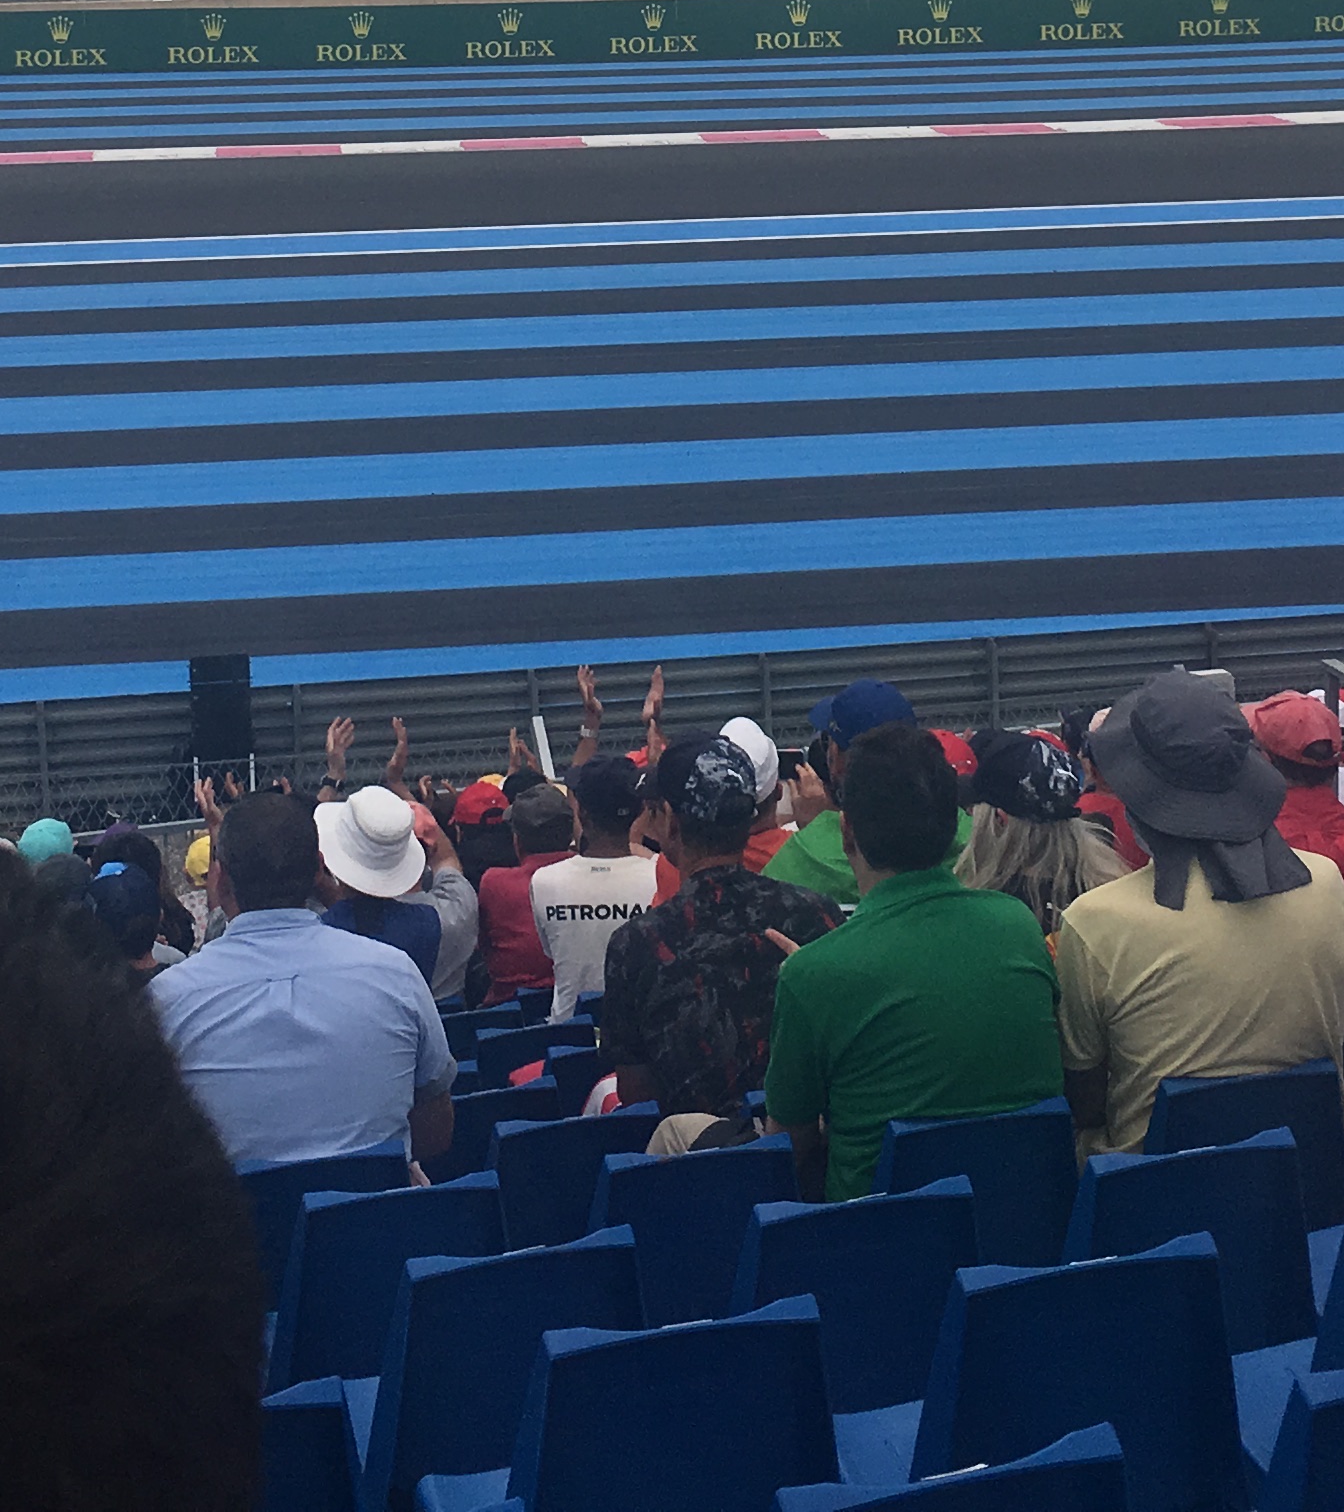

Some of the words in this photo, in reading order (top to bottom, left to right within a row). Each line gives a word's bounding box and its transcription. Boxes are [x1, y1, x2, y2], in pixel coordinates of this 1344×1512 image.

[897, 26, 982, 46] ROLEX
[1039, 23, 1124, 41] ROLEX
[1178, 18, 1261, 37] ROLEX
[465, 39, 555, 59] ROLEX
[609, 35, 696, 54] ROLEX
[755, 31, 842, 50] ROLEX
[14, 48, 105, 67] ROLEX
[167, 45, 257, 64] ROLEX
[316, 43, 406, 62] ROLEX
[546, 904, 653, 922] PETRONA
